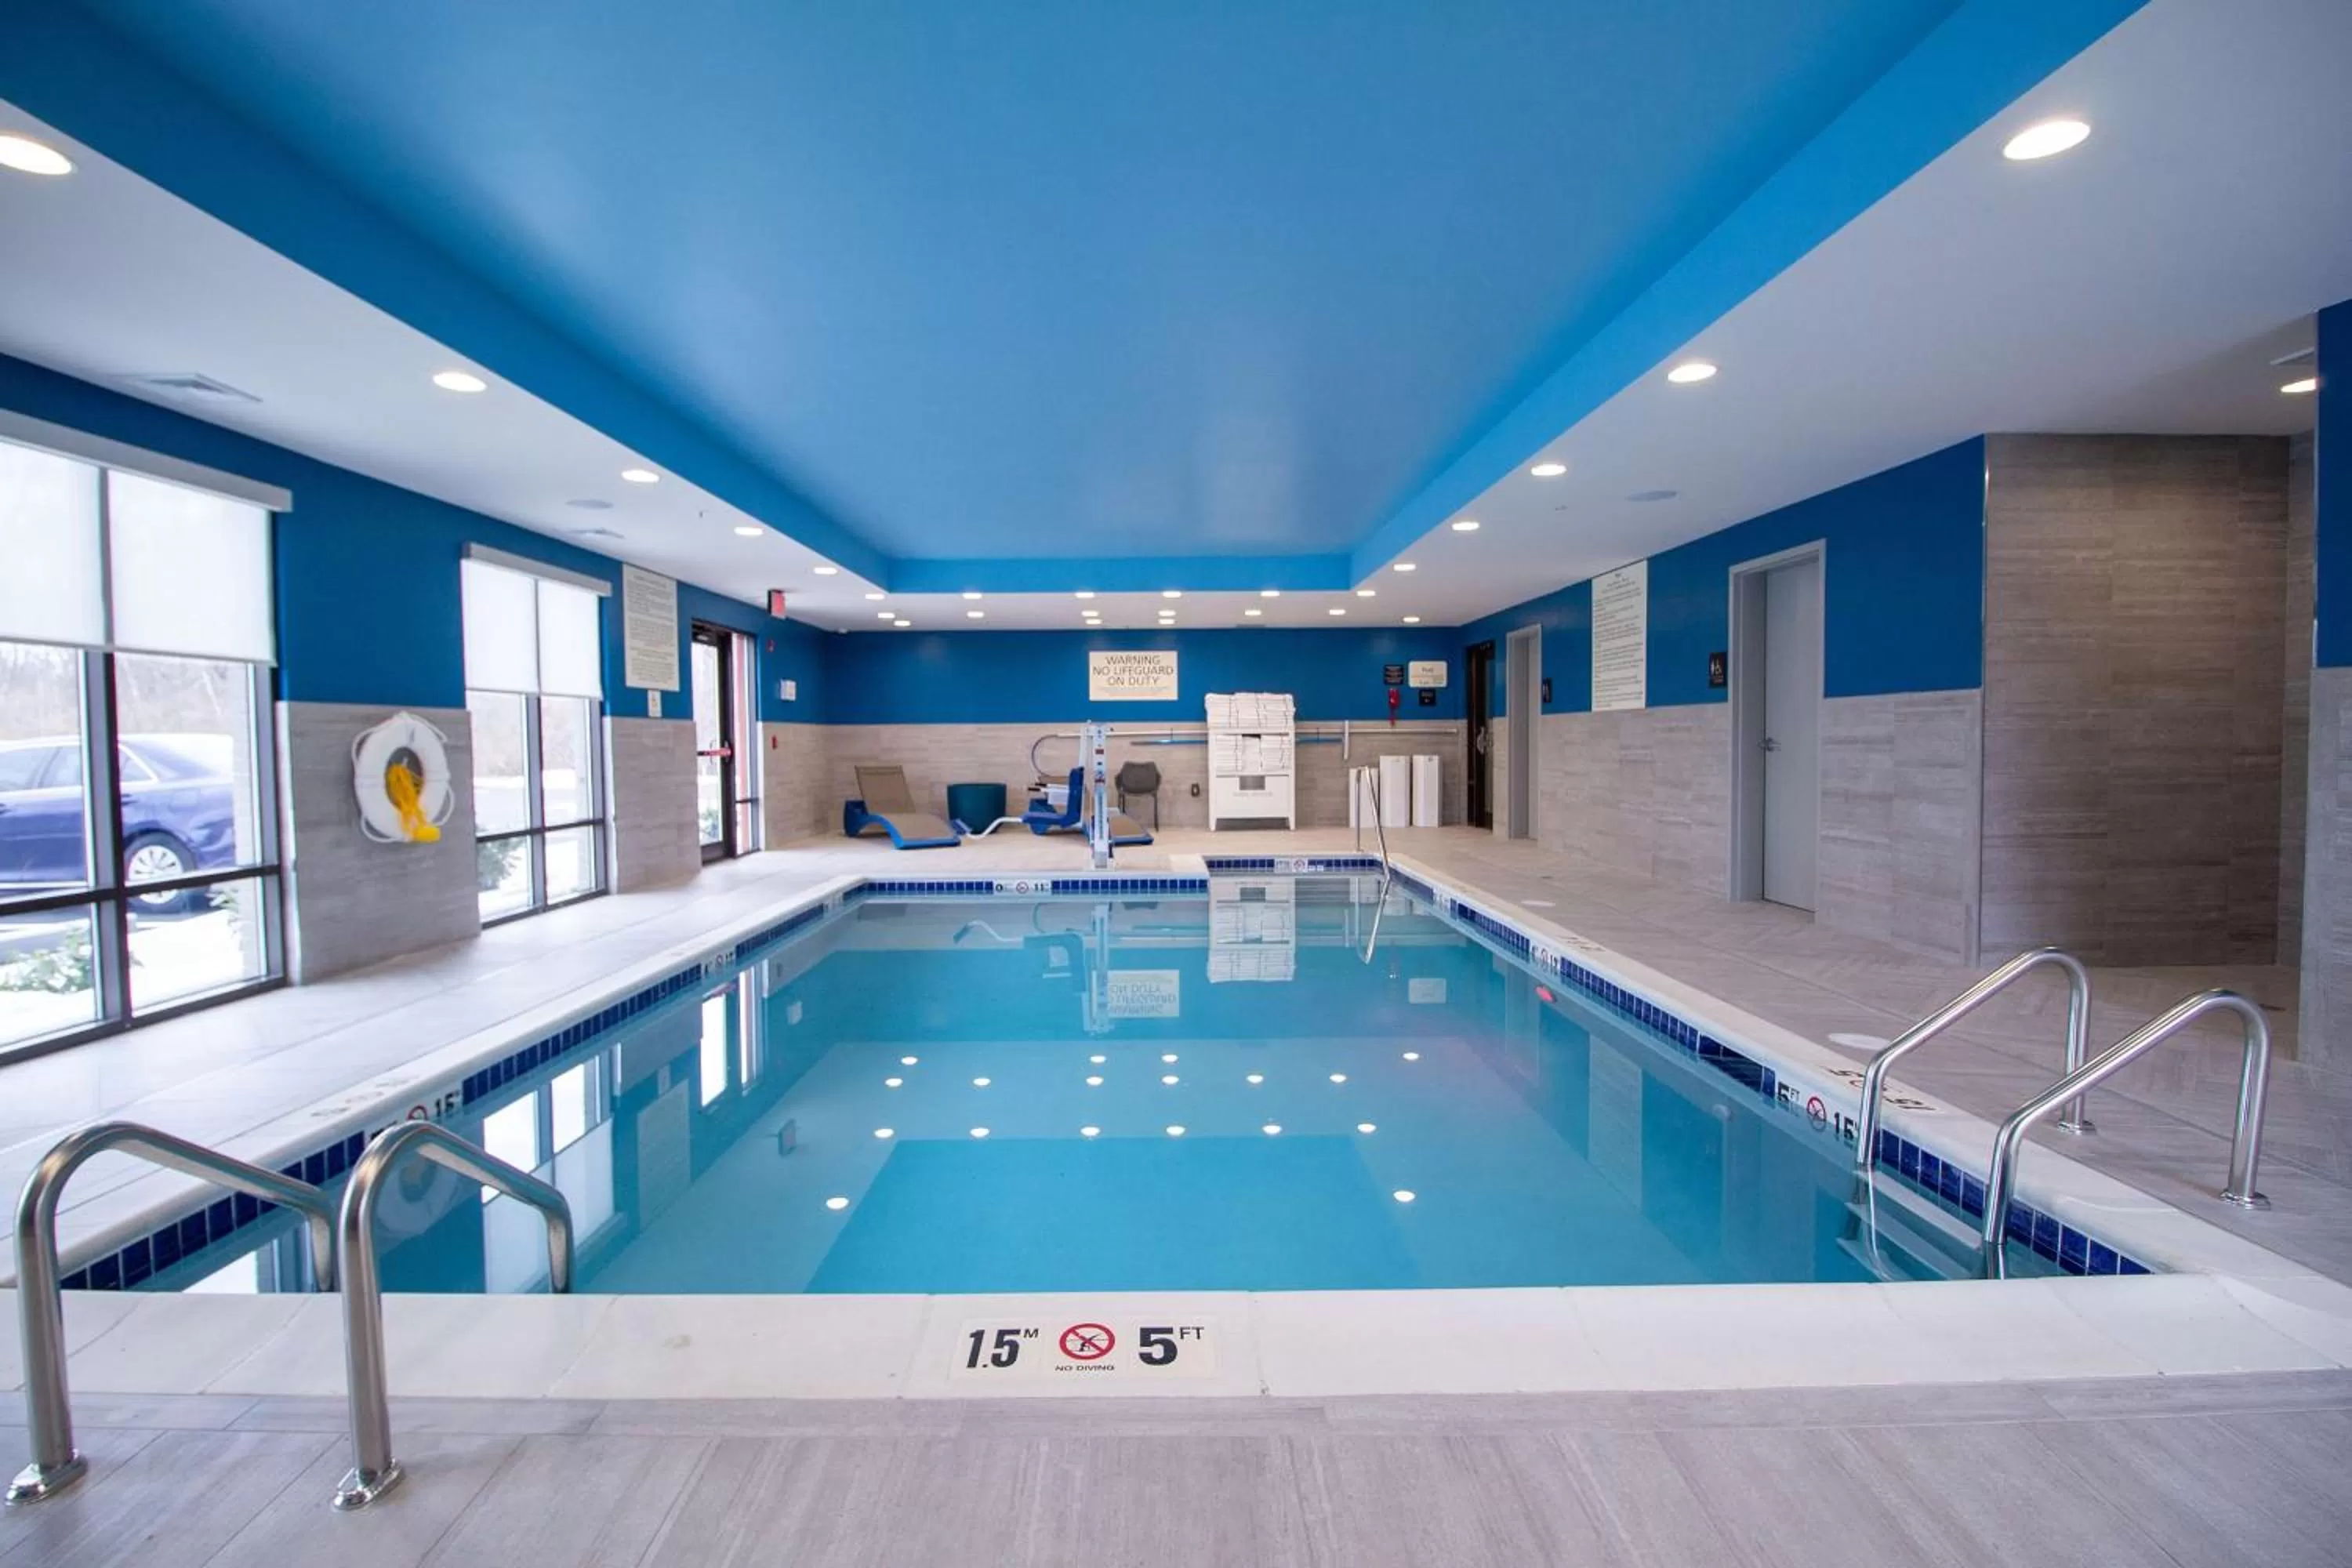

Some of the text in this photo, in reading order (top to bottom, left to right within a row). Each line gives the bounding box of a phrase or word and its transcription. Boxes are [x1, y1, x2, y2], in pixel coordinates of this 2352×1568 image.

[1105, 655, 1161, 665] WARNING
[1093, 666, 1174, 676] NO LIFEGUARD
[1107, 676, 1159, 686] ON DUTY
